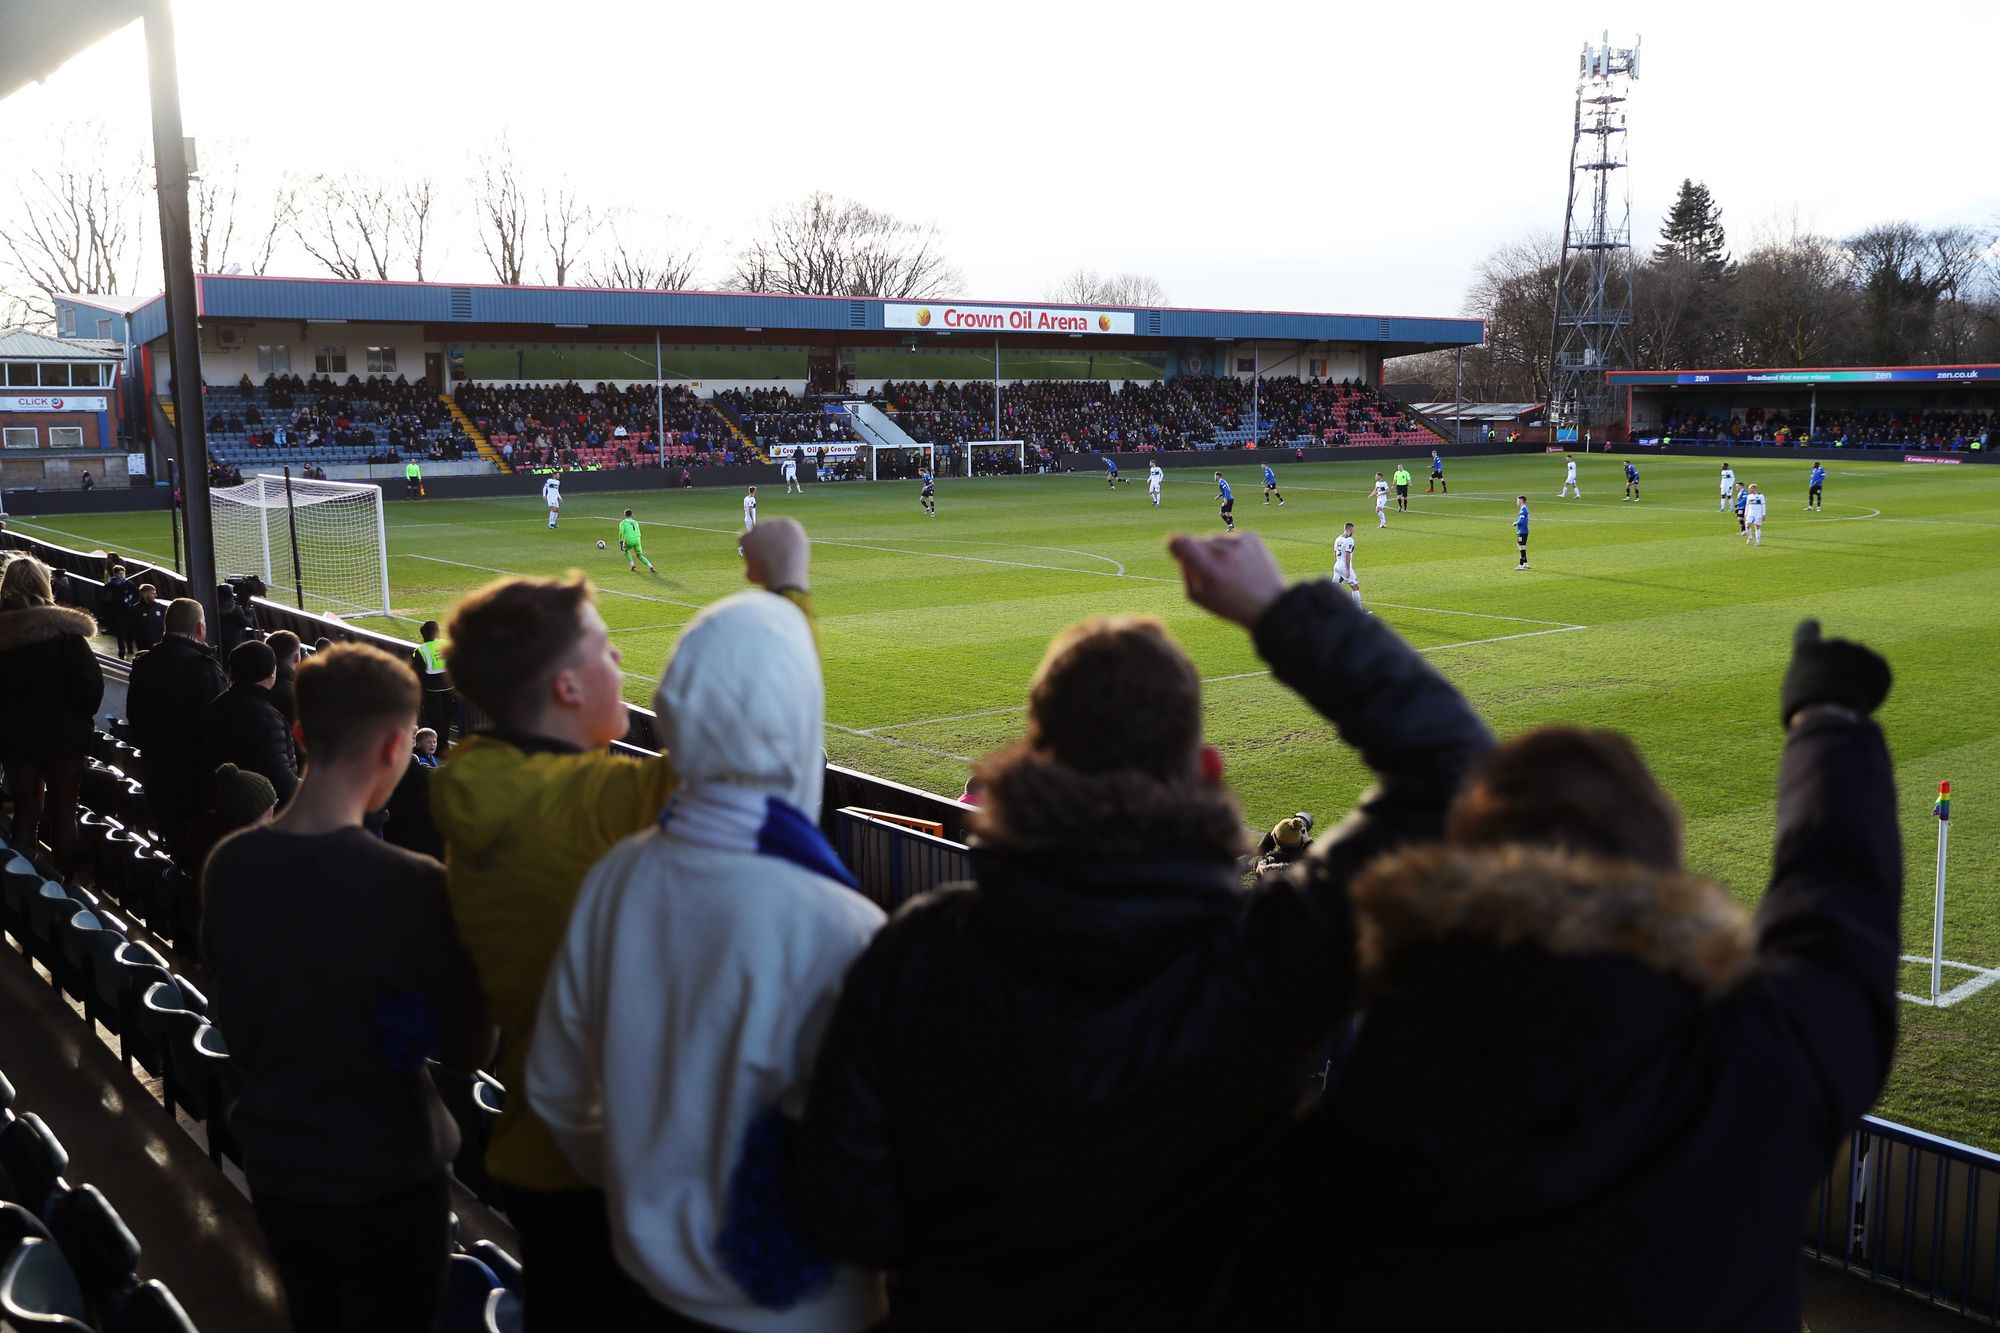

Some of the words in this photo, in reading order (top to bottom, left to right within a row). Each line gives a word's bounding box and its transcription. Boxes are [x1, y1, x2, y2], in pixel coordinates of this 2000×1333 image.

[944, 309, 1004, 328] Crown
[1009, 311, 1032, 329] Oil
[1038, 312, 1088, 330] Arena
[1937, 370, 1978, 379] zen.co.uk
